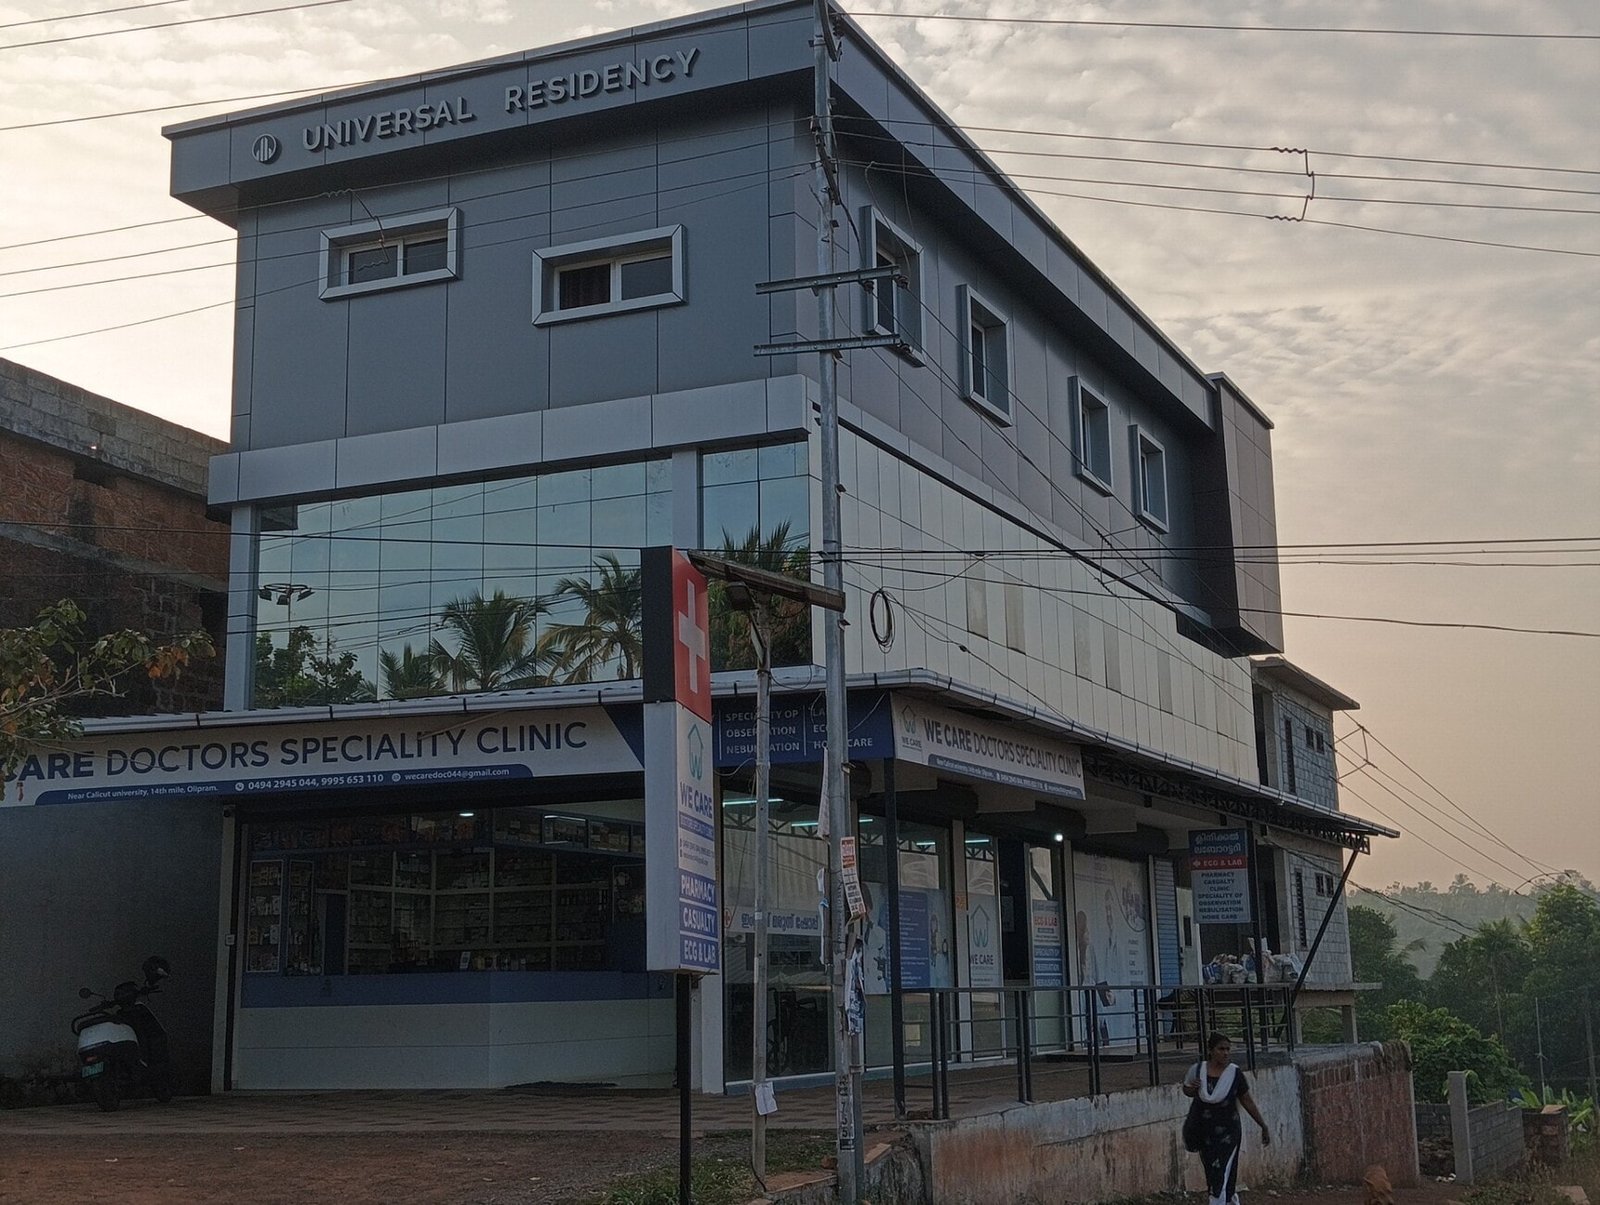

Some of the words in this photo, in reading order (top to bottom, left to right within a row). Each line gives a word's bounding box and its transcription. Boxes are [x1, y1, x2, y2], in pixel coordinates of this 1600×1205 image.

[302, 96, 475, 151] UNIVERSAL
[505, 48, 702, 111] RESIDENCY
[813, 707, 826, 717] LA
[813, 724, 826, 733] EC
[106, 741, 270, 777] DOCTORS
[280, 728, 466, 766] SPECIALITY
[476, 721, 587, 755] CLINIC
[923, 718, 942, 744] WE
[944, 724, 972, 752] CARE
[973, 733, 1015, 763] DOCTORS
[1015, 744, 1056, 772] SPECIALITY
[1058, 754, 1082, 778] CLINIC
[247, 781, 271, 790] 0494
[272, 779, 298, 789] 2945
[298, 778, 319, 788] 044,
[321, 777, 345, 787] 9995
[346, 775, 364, 785] 653
[366, 774, 384, 783] 110
[404, 767, 510, 781] wecaredoc044@gmail.com
[67, 792, 84, 800] Near
[86, 790, 111, 799] Calicut
[112, 788, 149, 799] university,
[150, 787, 167, 796] 14th
[680, 782, 693, 809] WE
[694, 789, 713, 819] CARE
[681, 874, 715, 903] PHARMACY
[683, 907, 715, 933] CASUALTY
[684, 939, 697, 961] ECG
[703, 943, 716, 964] LAB
[979, 954, 993, 965] CARE
